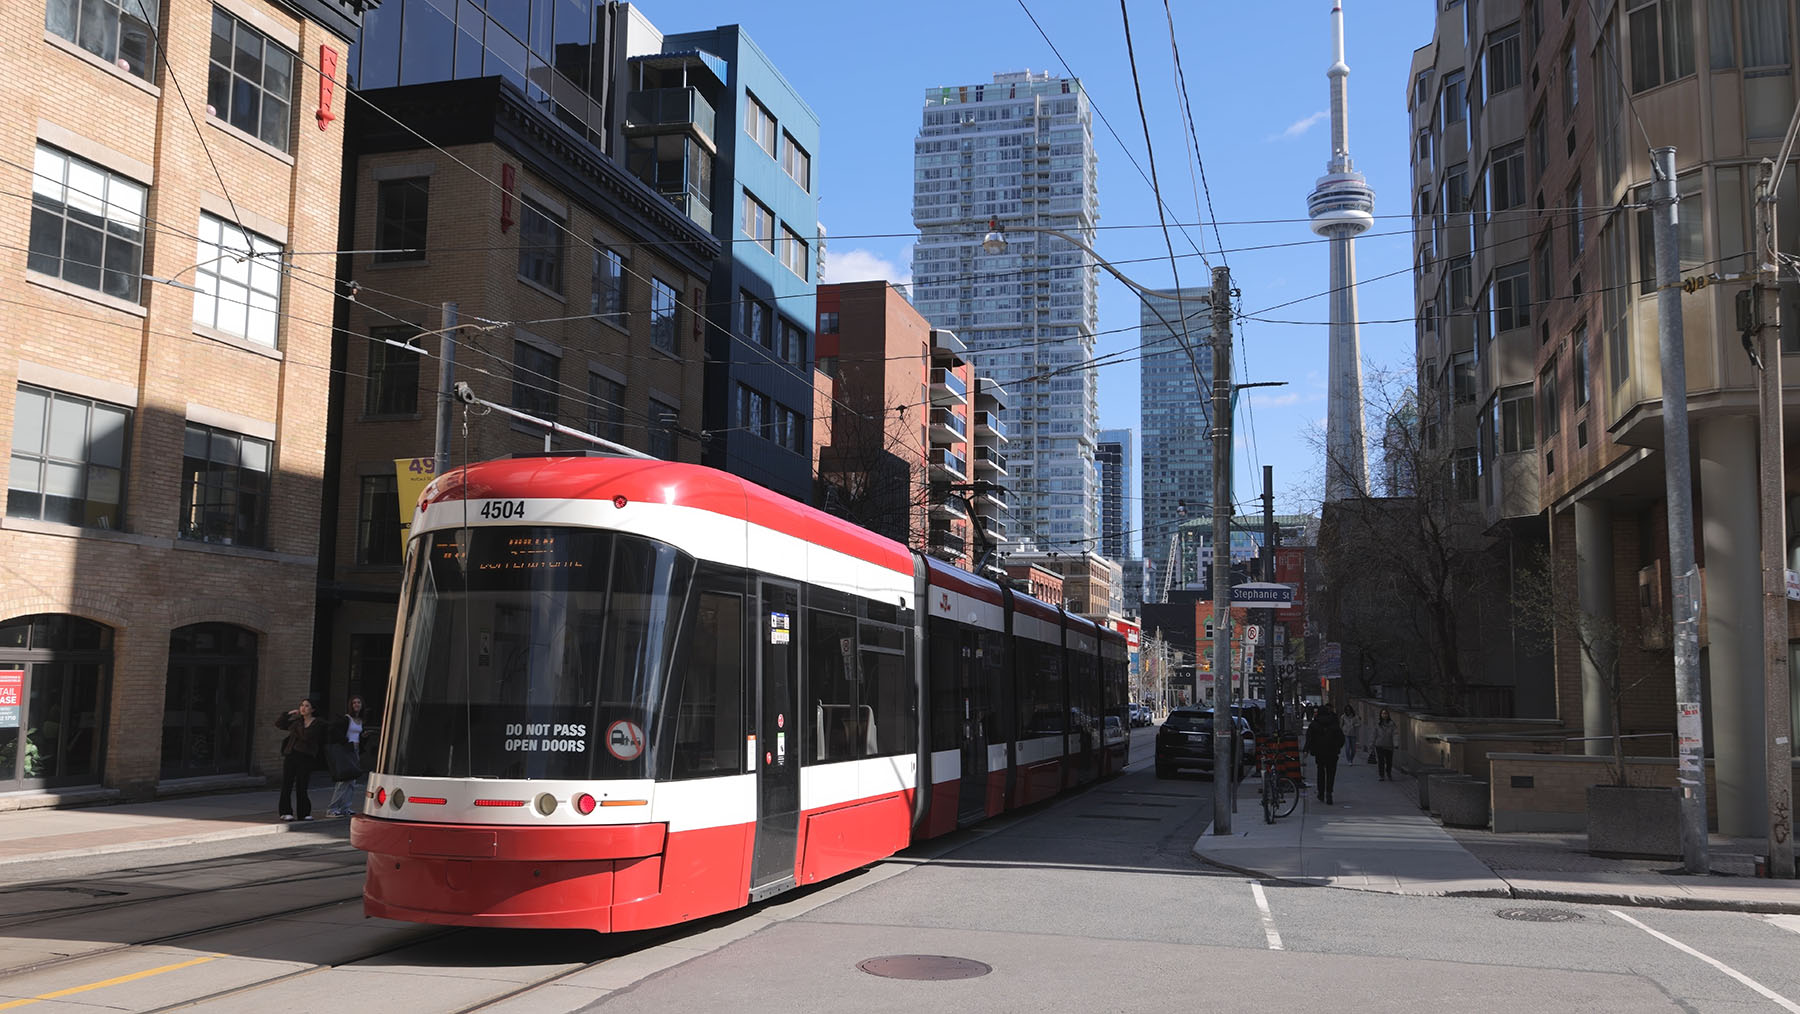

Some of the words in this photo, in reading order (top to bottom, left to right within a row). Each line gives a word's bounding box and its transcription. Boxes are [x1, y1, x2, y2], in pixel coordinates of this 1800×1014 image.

[409, 457, 435, 474] 49
[480, 500, 525, 519] 4504
[1234, 589, 1278, 600] Stephanie
[1282, 591, 1290, 599] St
[506, 724, 523, 736] DO
[526, 724, 550, 736] NOT
[553, 724, 586, 737] PASS
[505, 739, 538, 751] OPEN
[541, 739, 585, 752] DOORS
